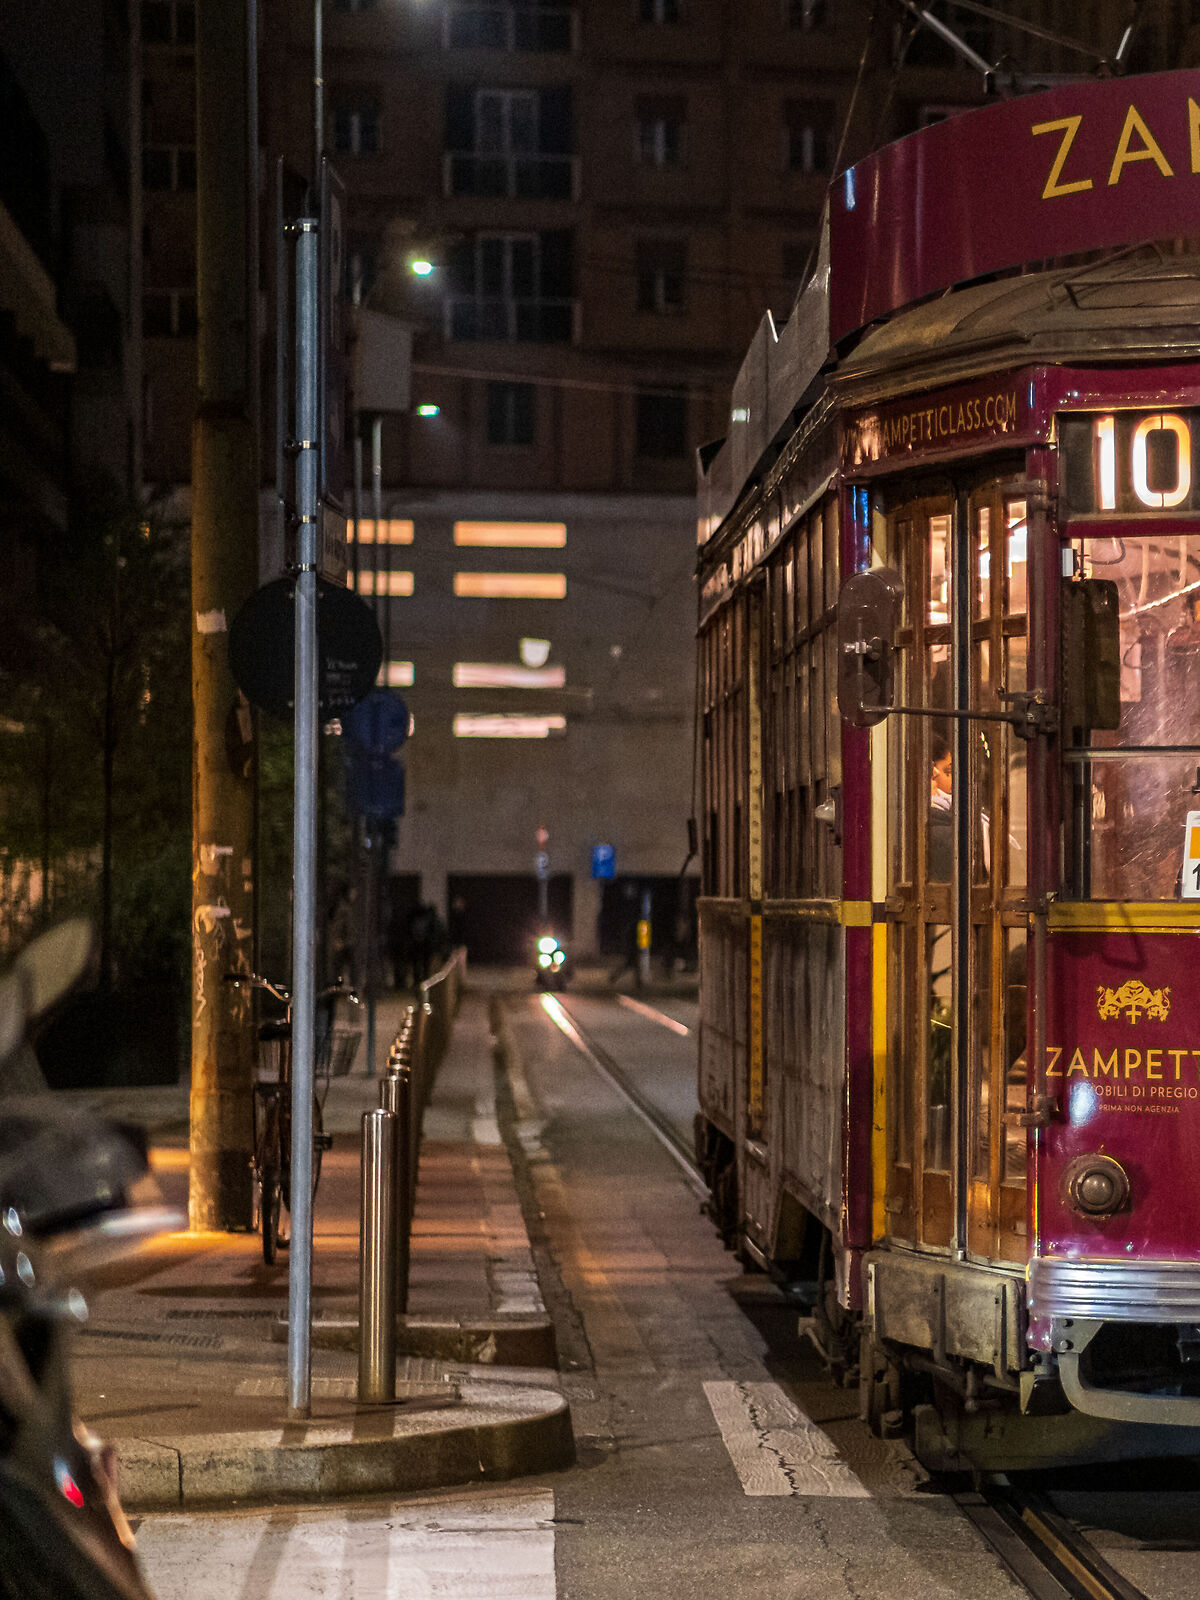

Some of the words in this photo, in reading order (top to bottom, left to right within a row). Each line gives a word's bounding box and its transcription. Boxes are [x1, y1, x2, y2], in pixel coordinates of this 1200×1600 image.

[1096, 414, 1192, 510] 10
[1132, 1085, 1146, 1097] DI
[1150, 1086, 1199, 1100] PREGIO
[1125, 1104, 1143, 1113] NON
